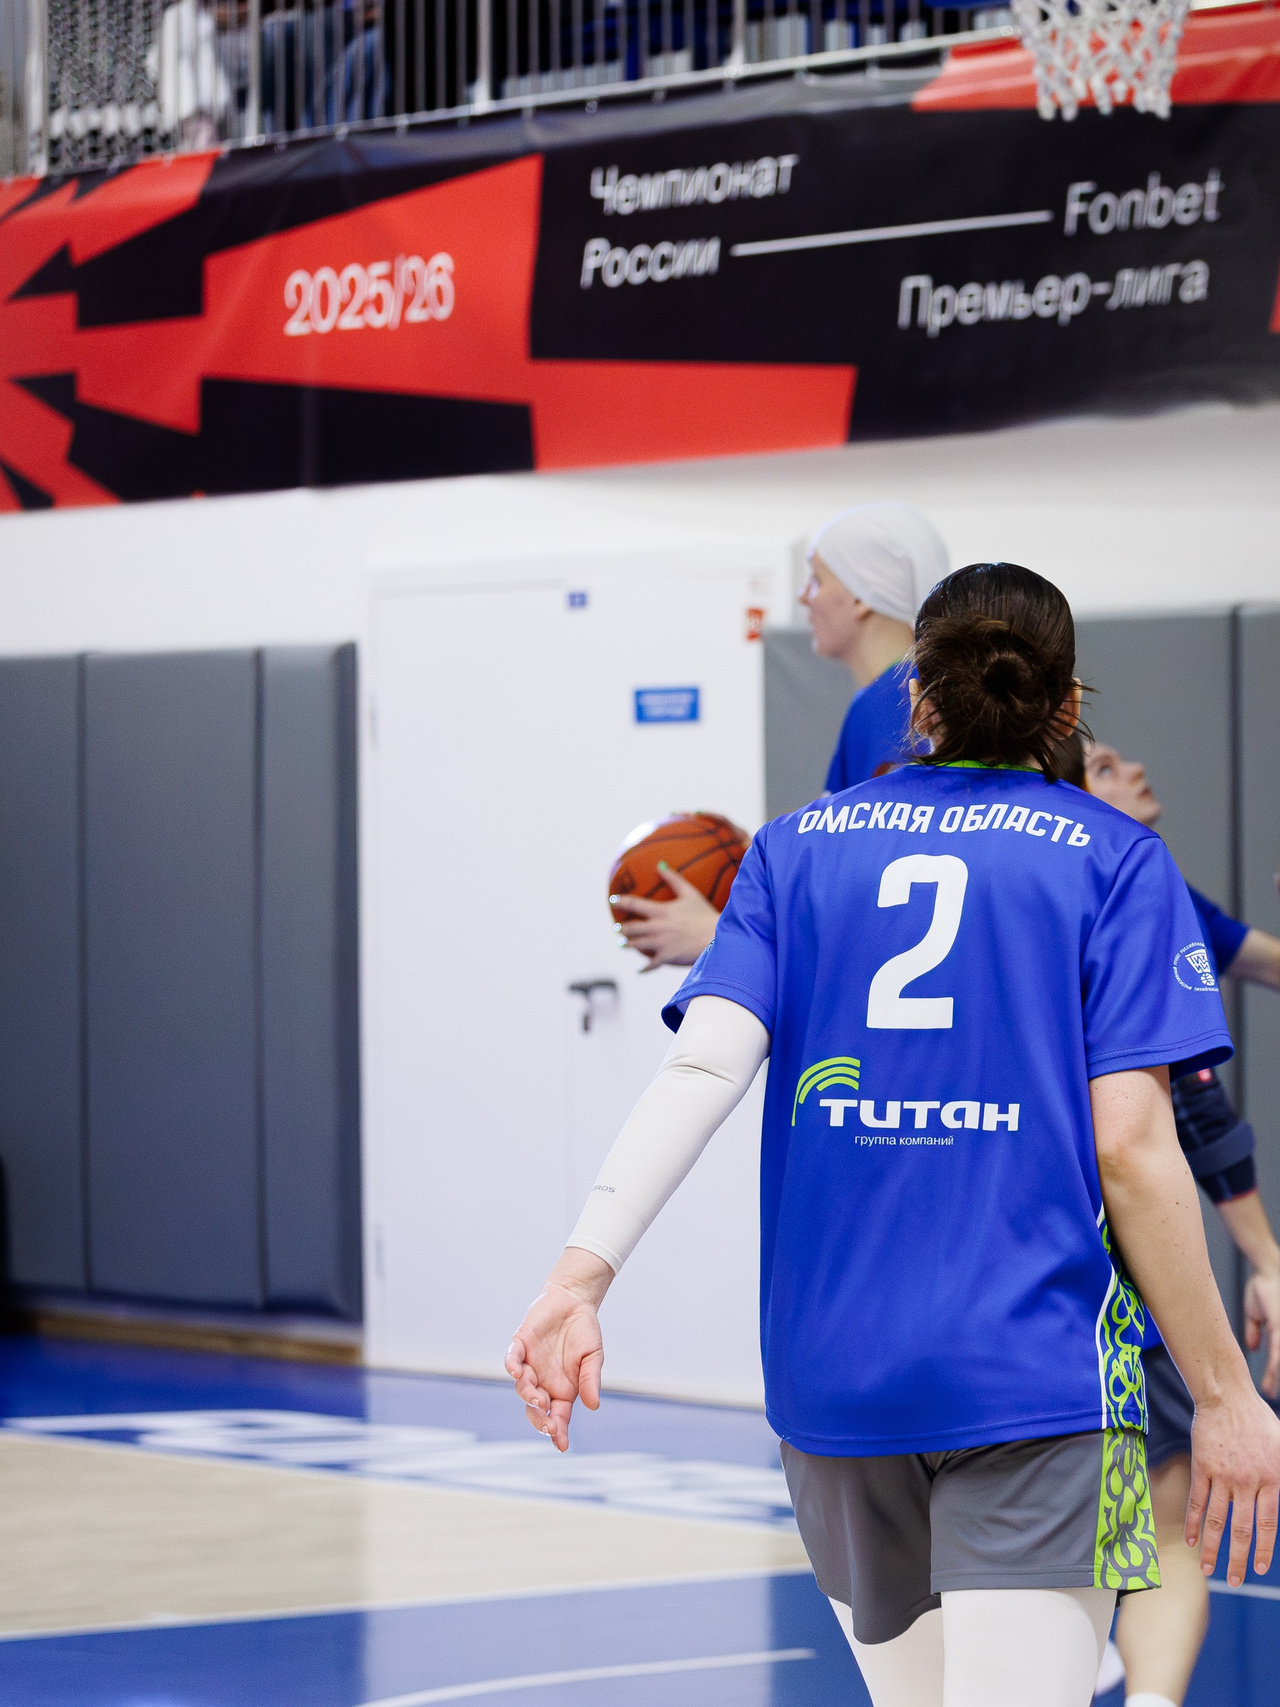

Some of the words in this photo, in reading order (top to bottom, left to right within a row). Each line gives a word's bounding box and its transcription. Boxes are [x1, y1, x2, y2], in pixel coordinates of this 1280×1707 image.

[591, 153, 800, 216] Чемпионат
[1063, 167, 1225, 237] Fonbet
[283, 252, 455, 337] 2025/26
[580, 236, 721, 290] России
[897, 258, 1211, 338] Премьер-лига
[797, 801, 936, 835] ОМСКАЯ
[938, 803, 1092, 848] ОБЛАСТЬ
[866, 853, 969, 1030] 2
[854, 1135, 897, 1147] группа
[899, 1134, 954, 1146] компаний
